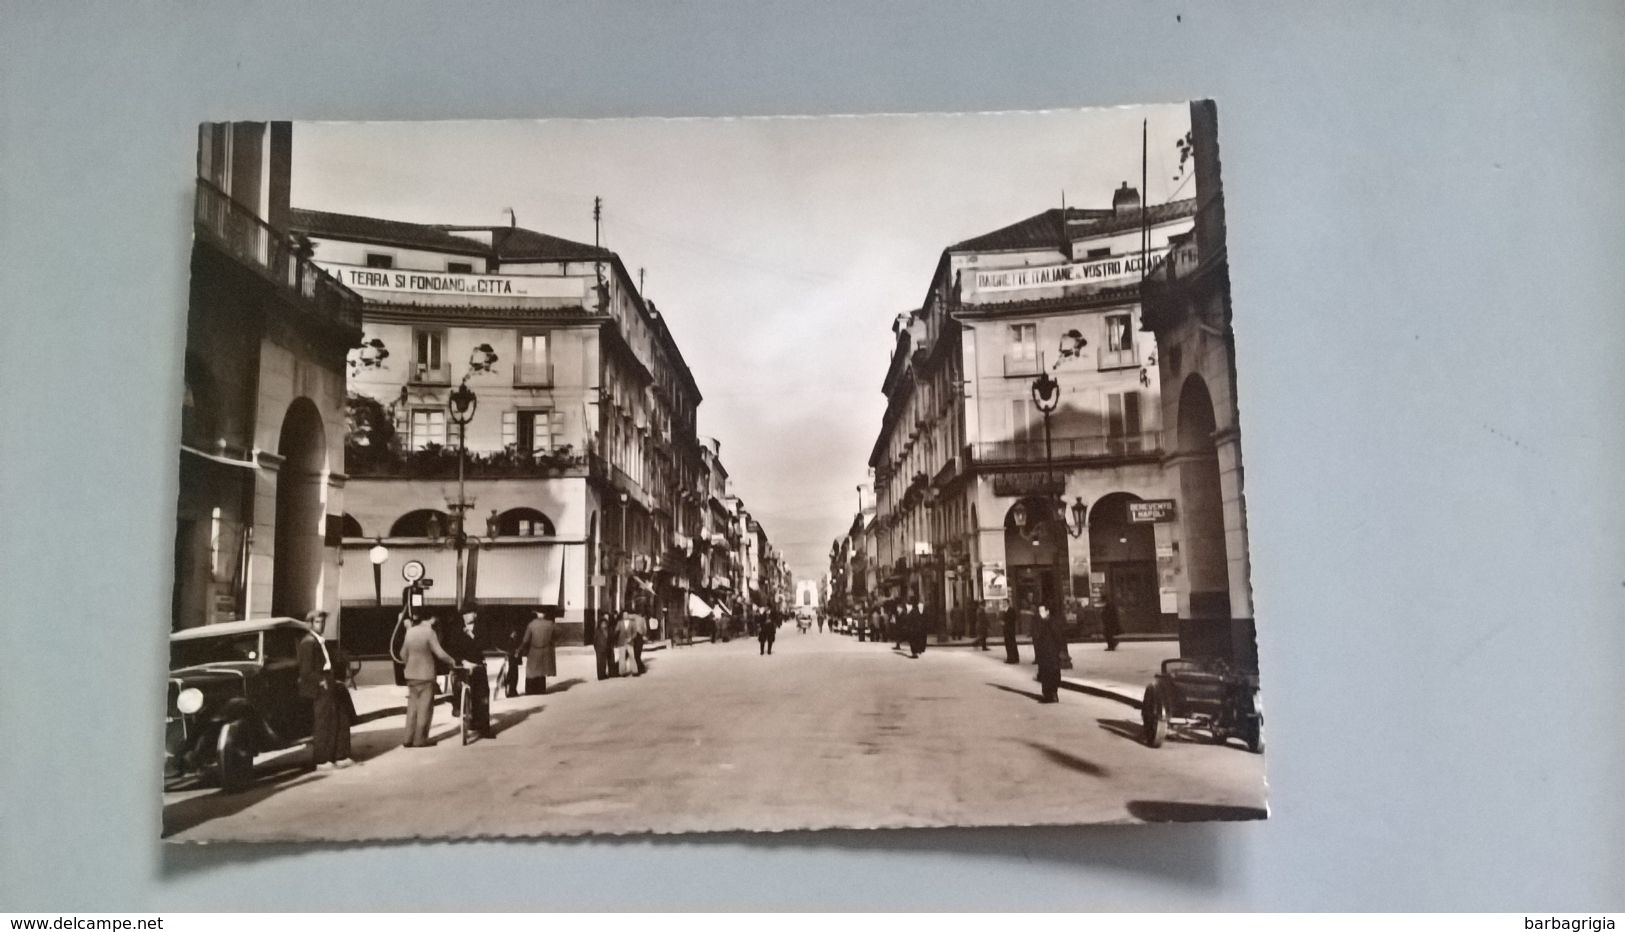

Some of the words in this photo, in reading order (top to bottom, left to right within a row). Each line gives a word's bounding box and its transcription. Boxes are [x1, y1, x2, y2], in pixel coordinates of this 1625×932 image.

[1083, 261, 1121, 278] VOSTRO
[349, 270, 389, 287] TERRA
[395, 274, 405, 288] SI
[410, 275, 465, 292] FONDANO
